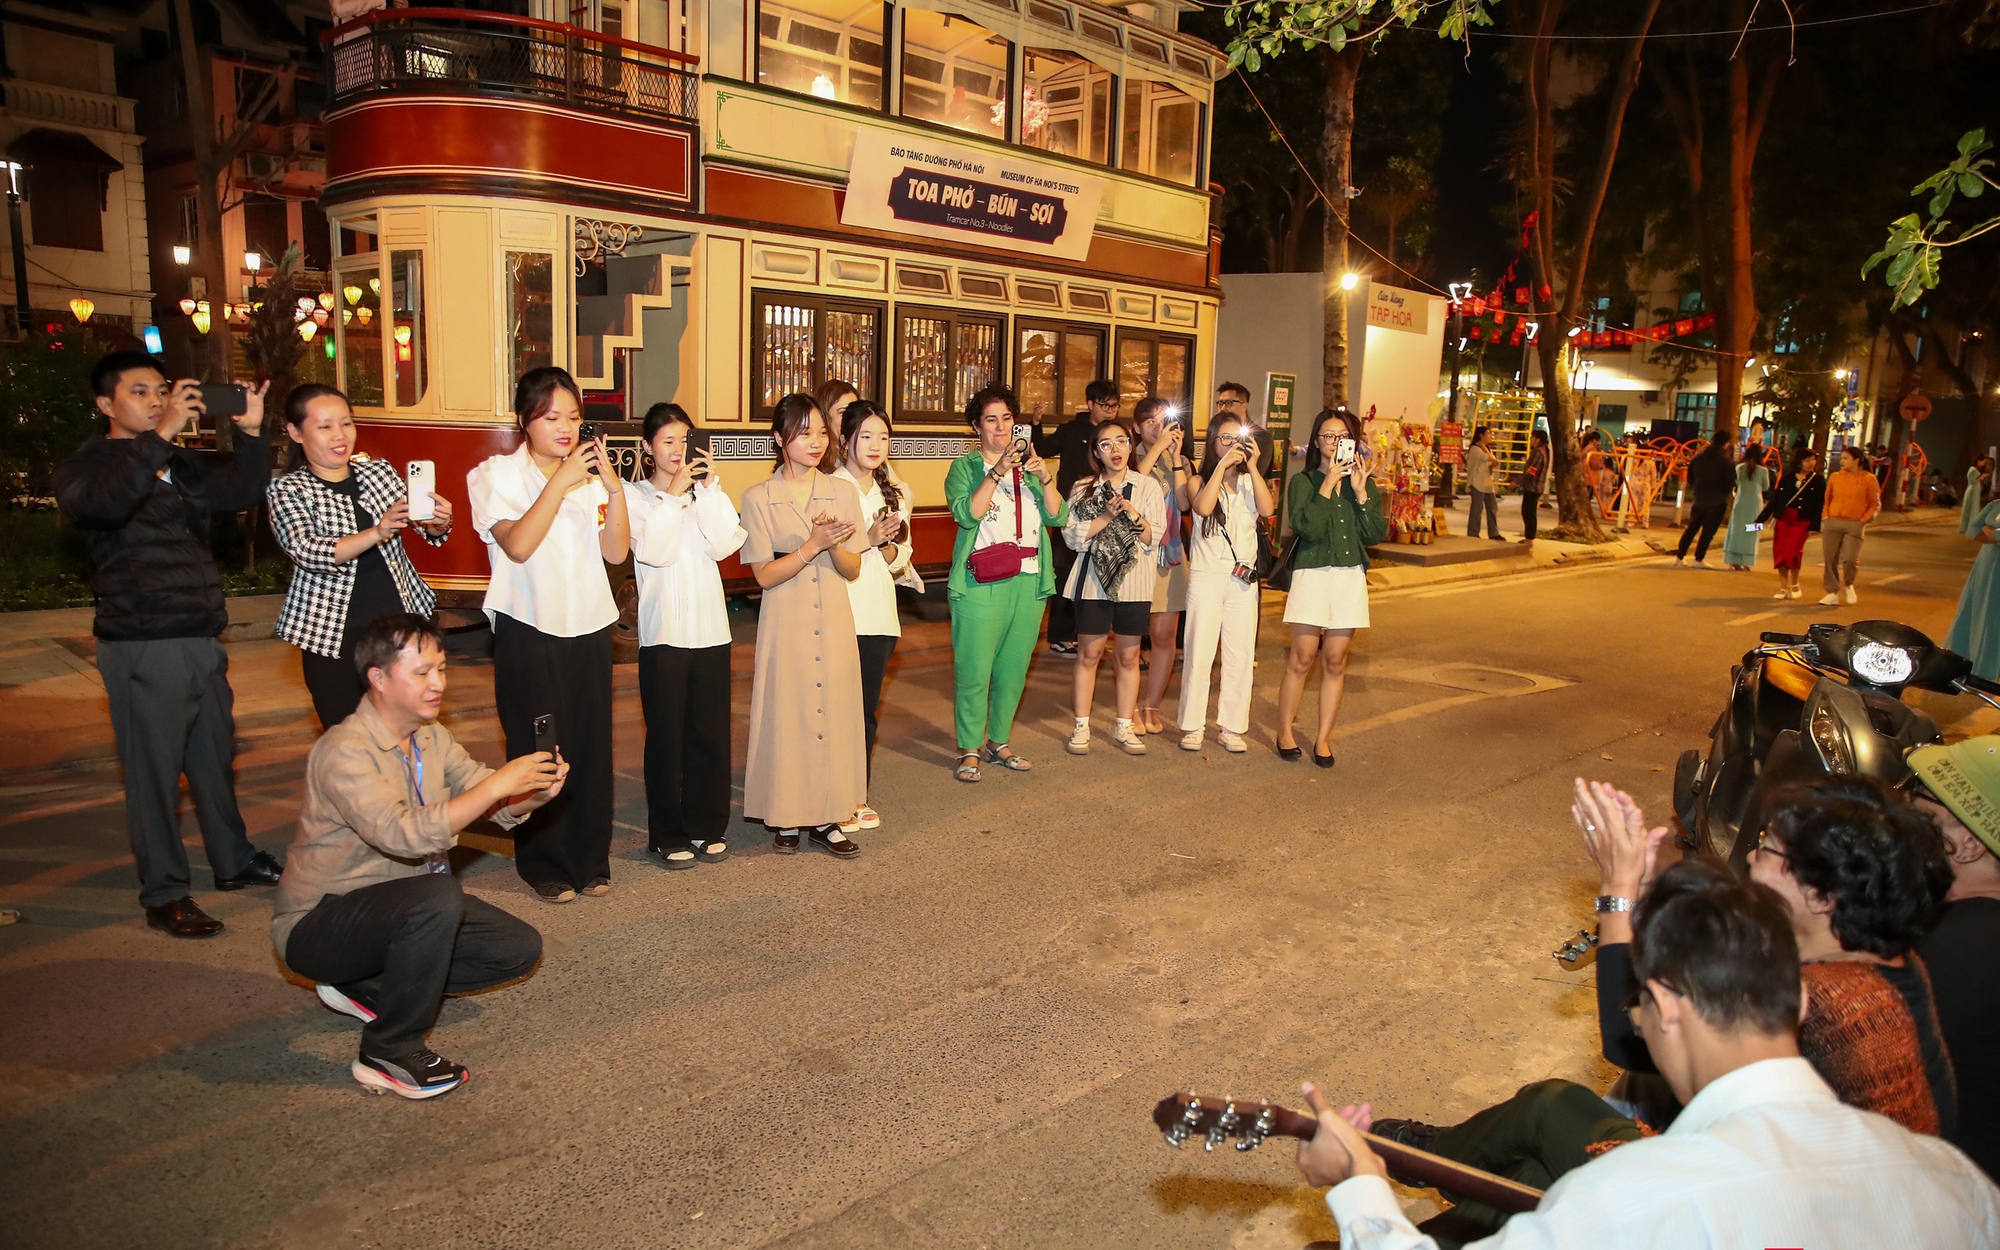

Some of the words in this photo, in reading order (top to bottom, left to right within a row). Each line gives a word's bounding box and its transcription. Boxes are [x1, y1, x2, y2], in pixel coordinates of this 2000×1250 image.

[1000, 170, 1025, 183] MUSEUM
[1026, 175, 1034, 184] OF
[1043, 179, 1057, 190] NOI'S
[1058, 182, 1079, 194] STREETS
[907, 178, 939, 206] TOA
[940, 184, 976, 210] PHỞ
[986, 192, 1019, 218] BÚN
[1029, 201, 1055, 226] SỢI
[946, 213, 970, 226] Tramcar
[970, 217, 985, 228] No.3
[988, 220, 1014, 233] Noodles
[1943, 782, 1961, 799] EM
